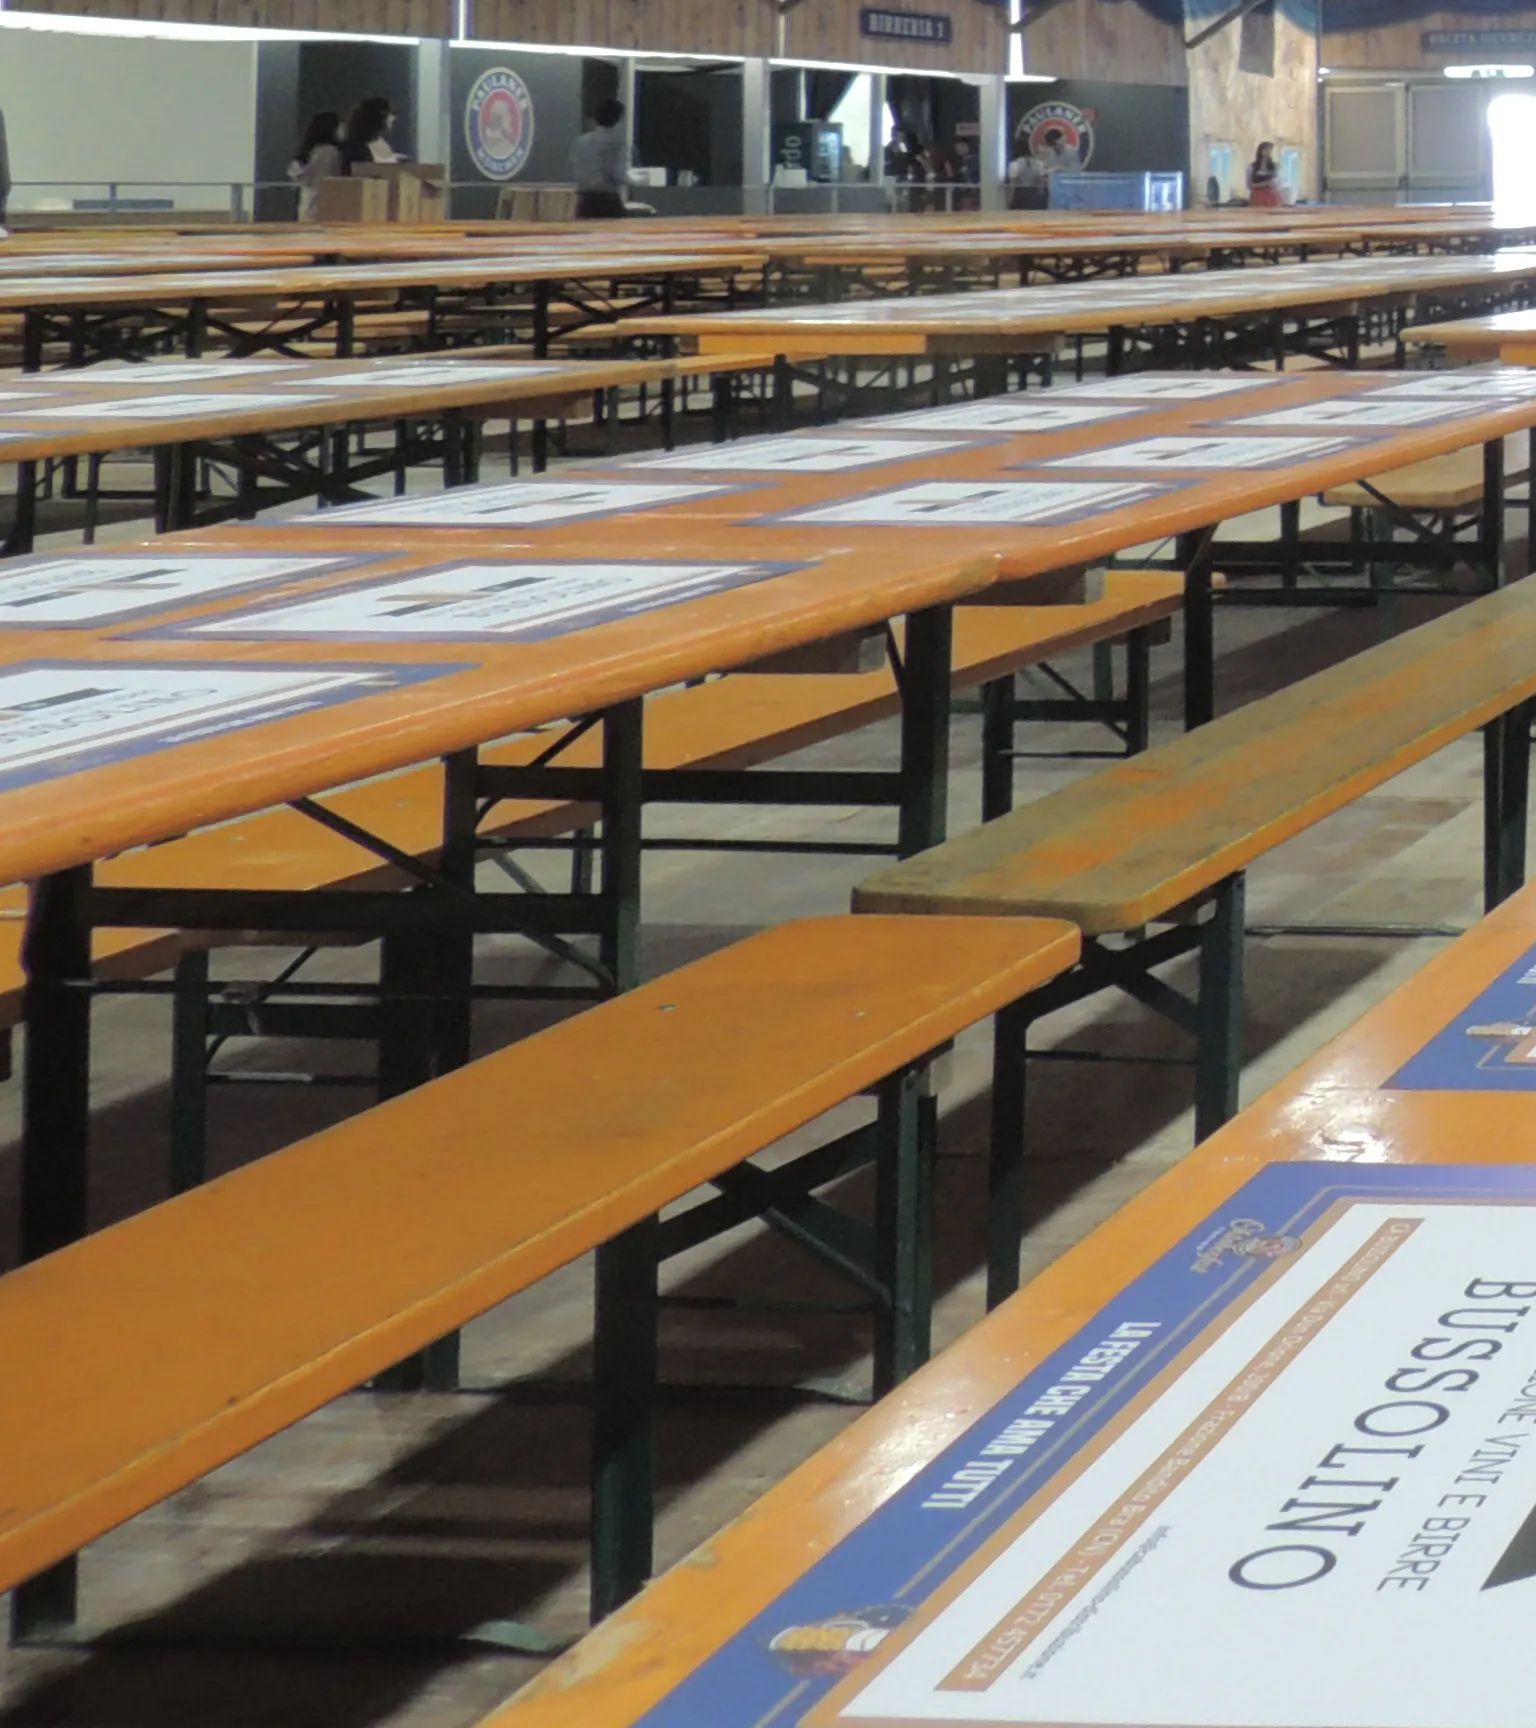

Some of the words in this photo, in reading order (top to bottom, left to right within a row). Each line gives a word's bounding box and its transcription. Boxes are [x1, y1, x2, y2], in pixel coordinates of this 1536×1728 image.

[1105, 1321, 1164, 1338] LA
[1057, 1340, 1143, 1381] FESTA
[1018, 1385, 1095, 1415] CHE
[976, 1419, 1060, 1454] AMA
[1170, 1410, 1237, 1455] Frazione
[1448, 1433, 1530, 1484] VINI
[916, 1459, 1016, 1508] TUTTI
[1128, 1458, 1192, 1499] Bandito
[1104, 1504, 1150, 1525] Bra
[1432, 1493, 1489, 1508] E
[1072, 1528, 1127, 1556] (CN)
[1371, 1516, 1474, 1591] BIRRE
[1043, 1566, 1091, 1588] Tel.
[1008, 1592, 1066, 1624] 0172
[955, 1627, 1034, 1679] 457734
